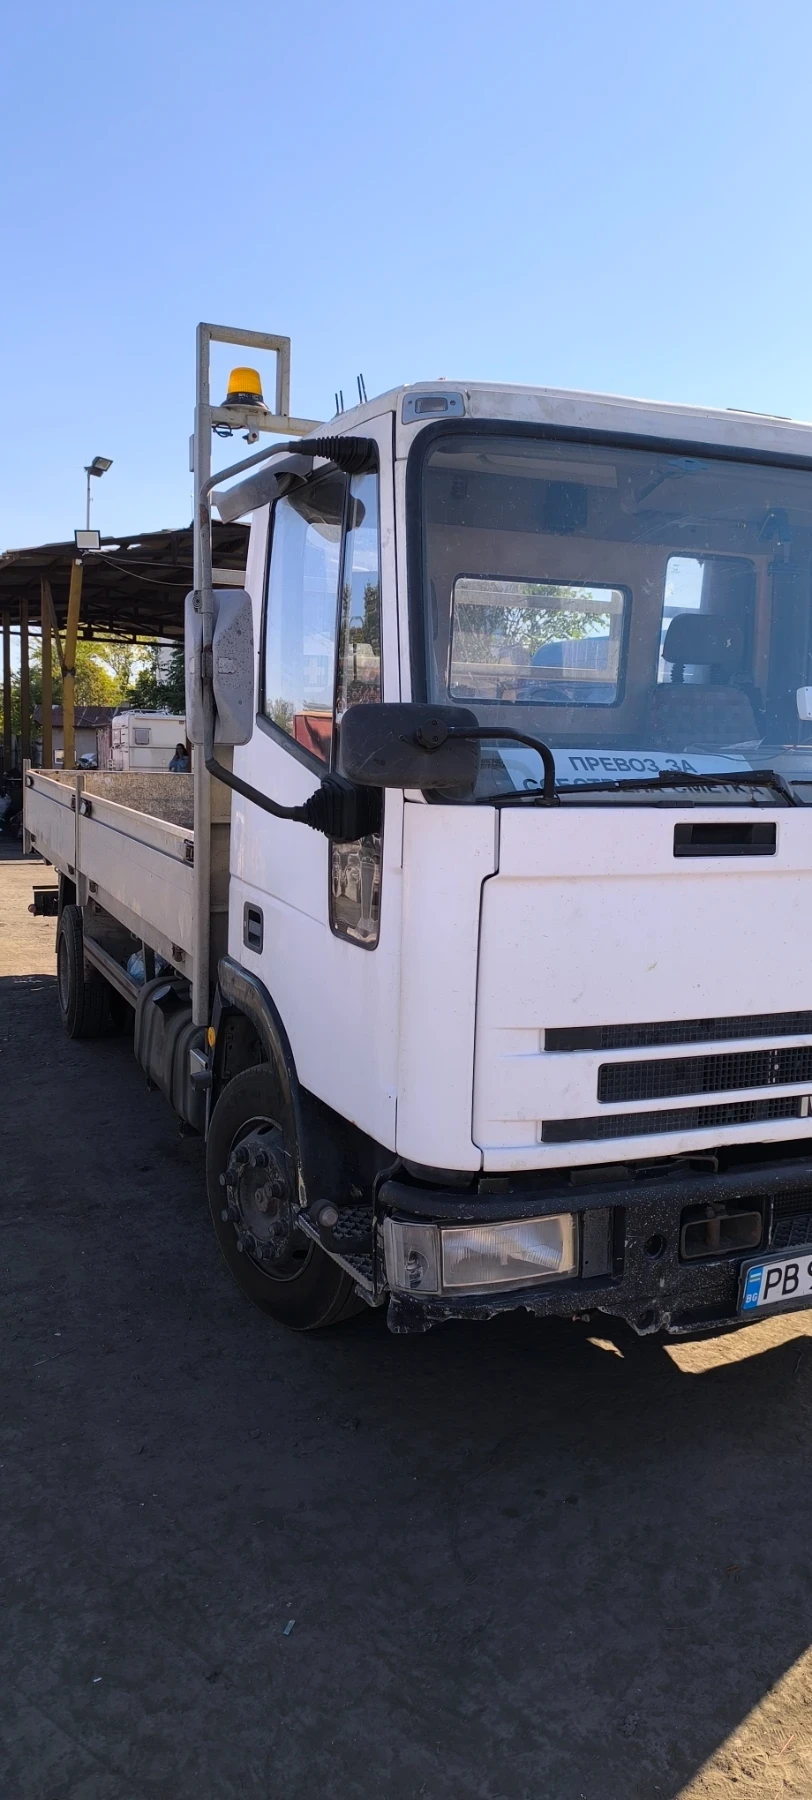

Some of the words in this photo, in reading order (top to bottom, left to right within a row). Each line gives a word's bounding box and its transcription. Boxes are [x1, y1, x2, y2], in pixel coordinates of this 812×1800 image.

[568, 756, 660, 773] ПРЕВОЗ
[665, 758, 698, 774] ЗА
[763, 1263, 800, 1300] PB
[745, 1292, 758, 1304] BG
